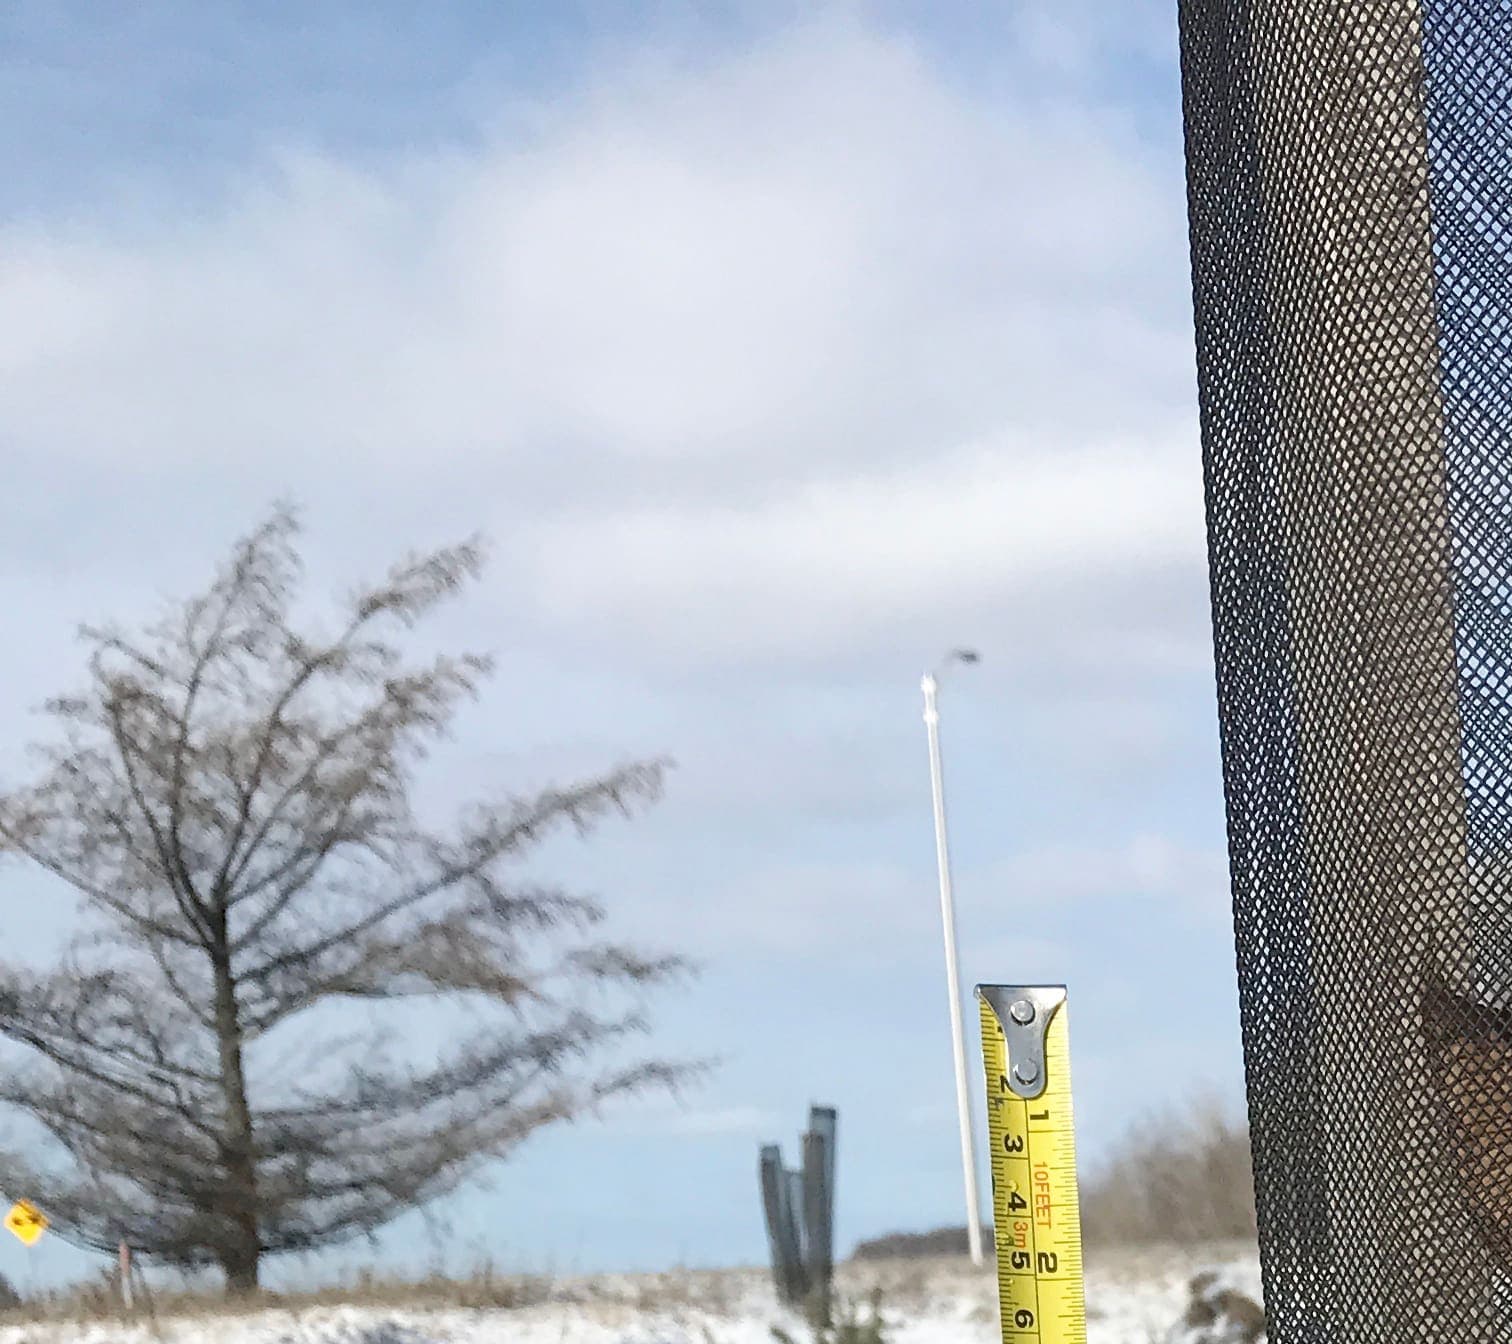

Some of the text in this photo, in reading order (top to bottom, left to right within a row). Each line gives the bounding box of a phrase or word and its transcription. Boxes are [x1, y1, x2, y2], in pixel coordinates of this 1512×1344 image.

[1029, 1109, 1050, 1123] 1
[1004, 1133, 1024, 1154] 3
[1007, 1191, 1028, 1213] 4
[1011, 1251, 1031, 1270] 5
[1037, 1251, 1058, 1274] 2
[1014, 1309, 1035, 1329] 6
